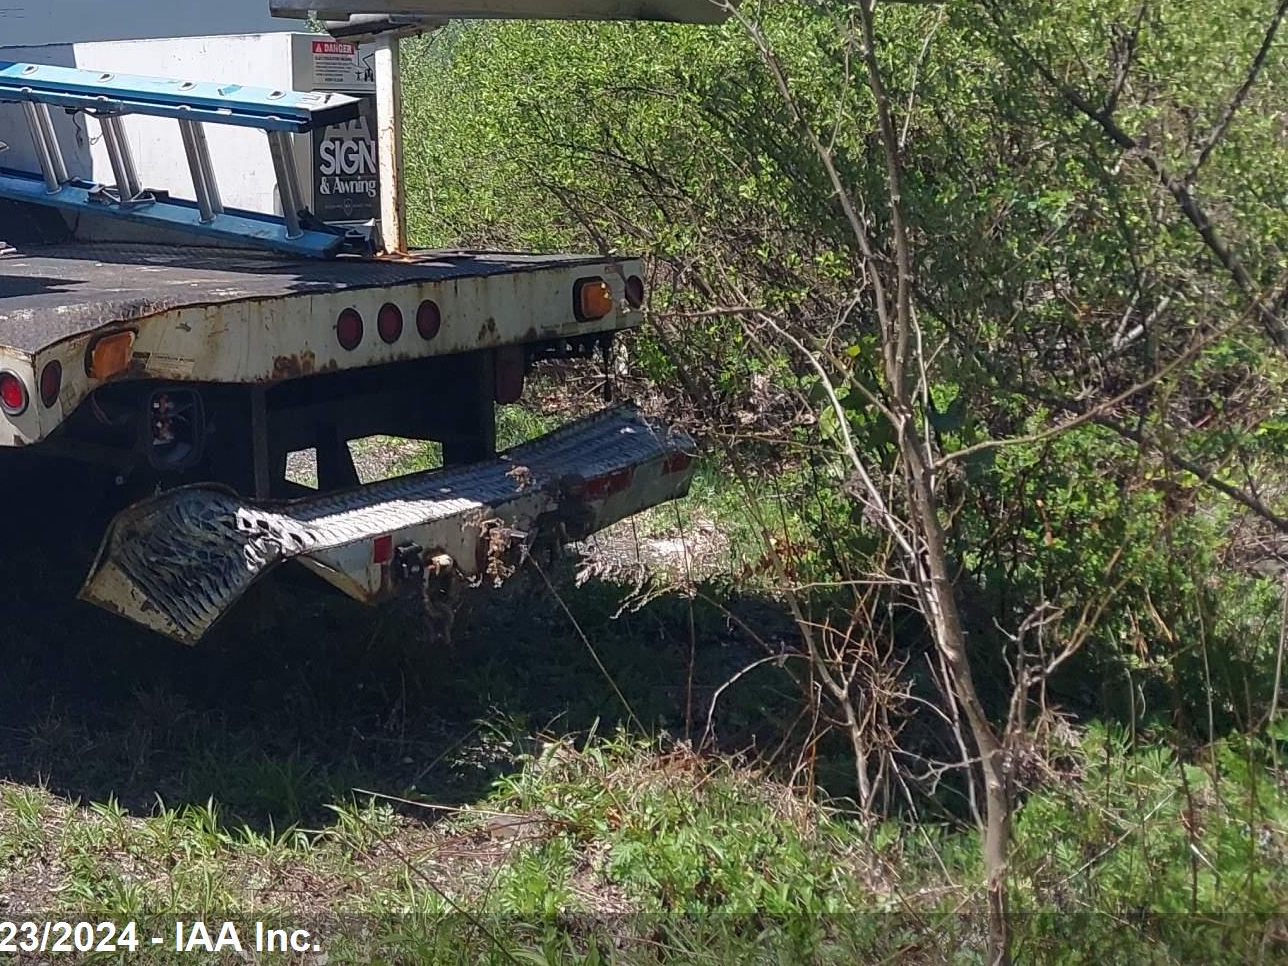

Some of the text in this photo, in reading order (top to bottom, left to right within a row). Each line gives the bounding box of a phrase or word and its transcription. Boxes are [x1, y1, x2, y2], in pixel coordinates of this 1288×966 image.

[323, 43, 353, 54] DANGER
[319, 140, 377, 175] SIGN
[319, 176, 377, 199] & Awning
